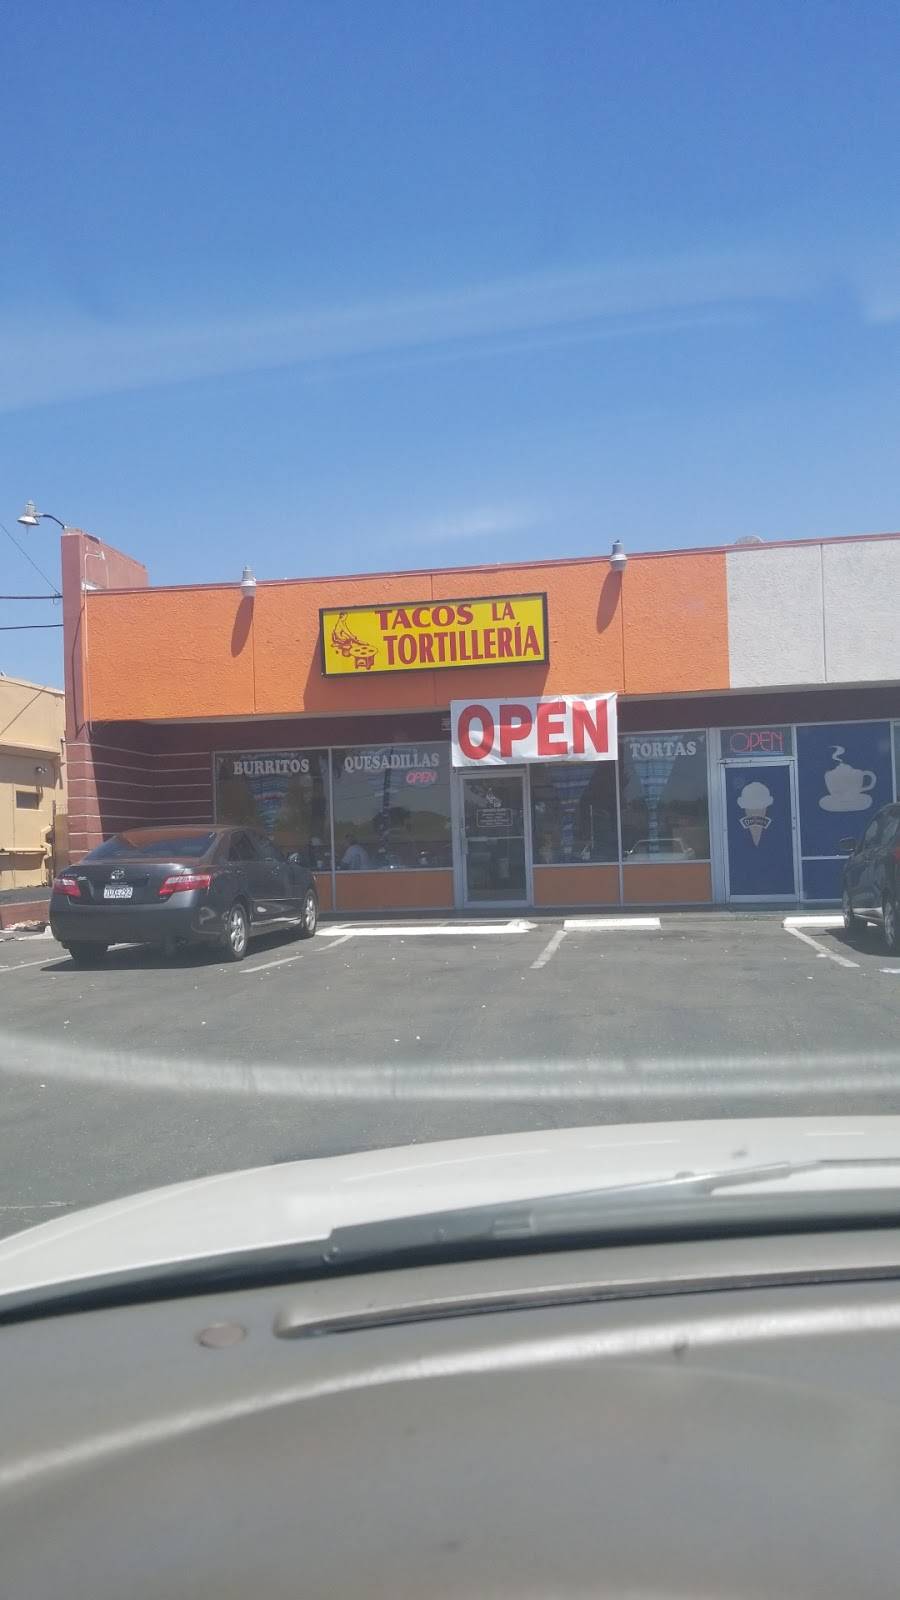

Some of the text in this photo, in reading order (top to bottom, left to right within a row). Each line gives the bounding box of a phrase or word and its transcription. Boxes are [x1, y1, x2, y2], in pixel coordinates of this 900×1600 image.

[375, 601, 516, 630] TACOS LA
[383, 622, 541, 665] TORTILLERÍA
[456, 700, 609, 760] OPEN
[630, 741, 697, 757] TORTAS
[730, 731, 784, 752] OPEN
[233, 759, 310, 775] BURRITOS
[344, 753, 440, 771] QUESADILLAS
[406, 770, 438, 784] OPEN
